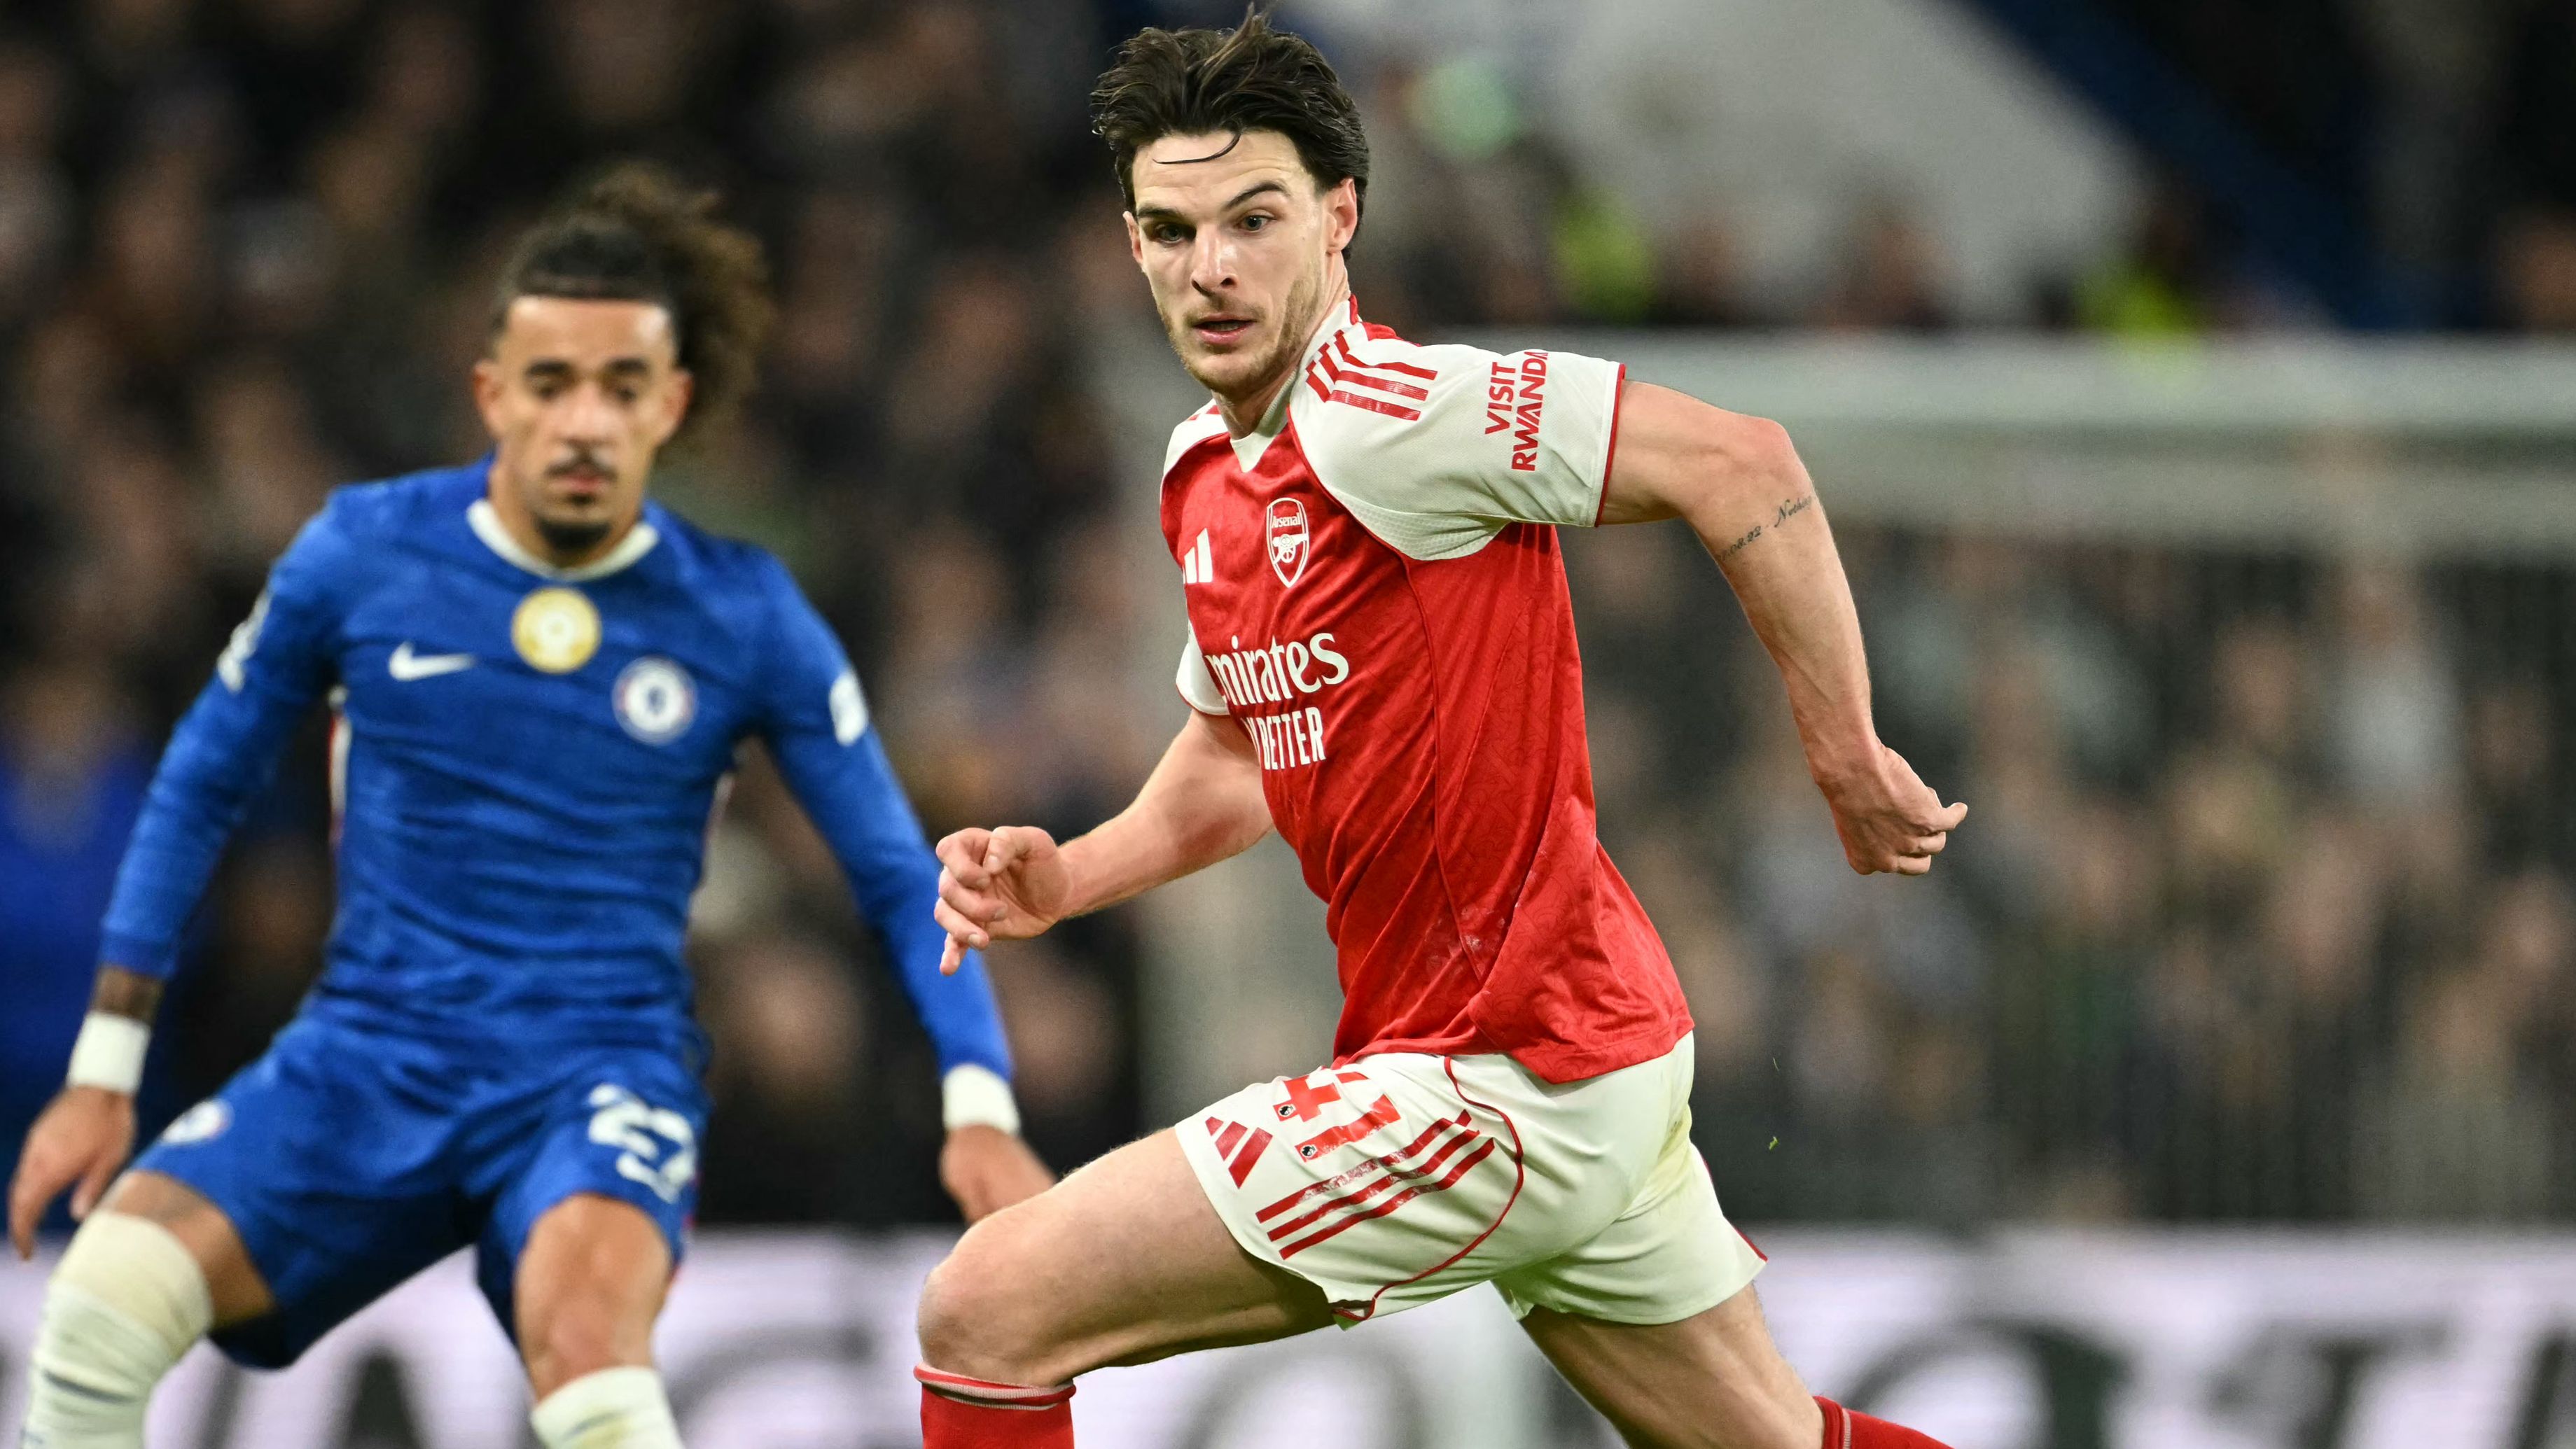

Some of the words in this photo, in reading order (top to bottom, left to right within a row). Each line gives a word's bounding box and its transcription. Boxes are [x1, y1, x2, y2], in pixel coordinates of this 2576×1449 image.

[1484, 361, 1517, 435] VISIT
[1271, 512, 1301, 528] Arsenal
[1204, 632, 1350, 706] mirates
[1255, 706, 1327, 771] BETTER
